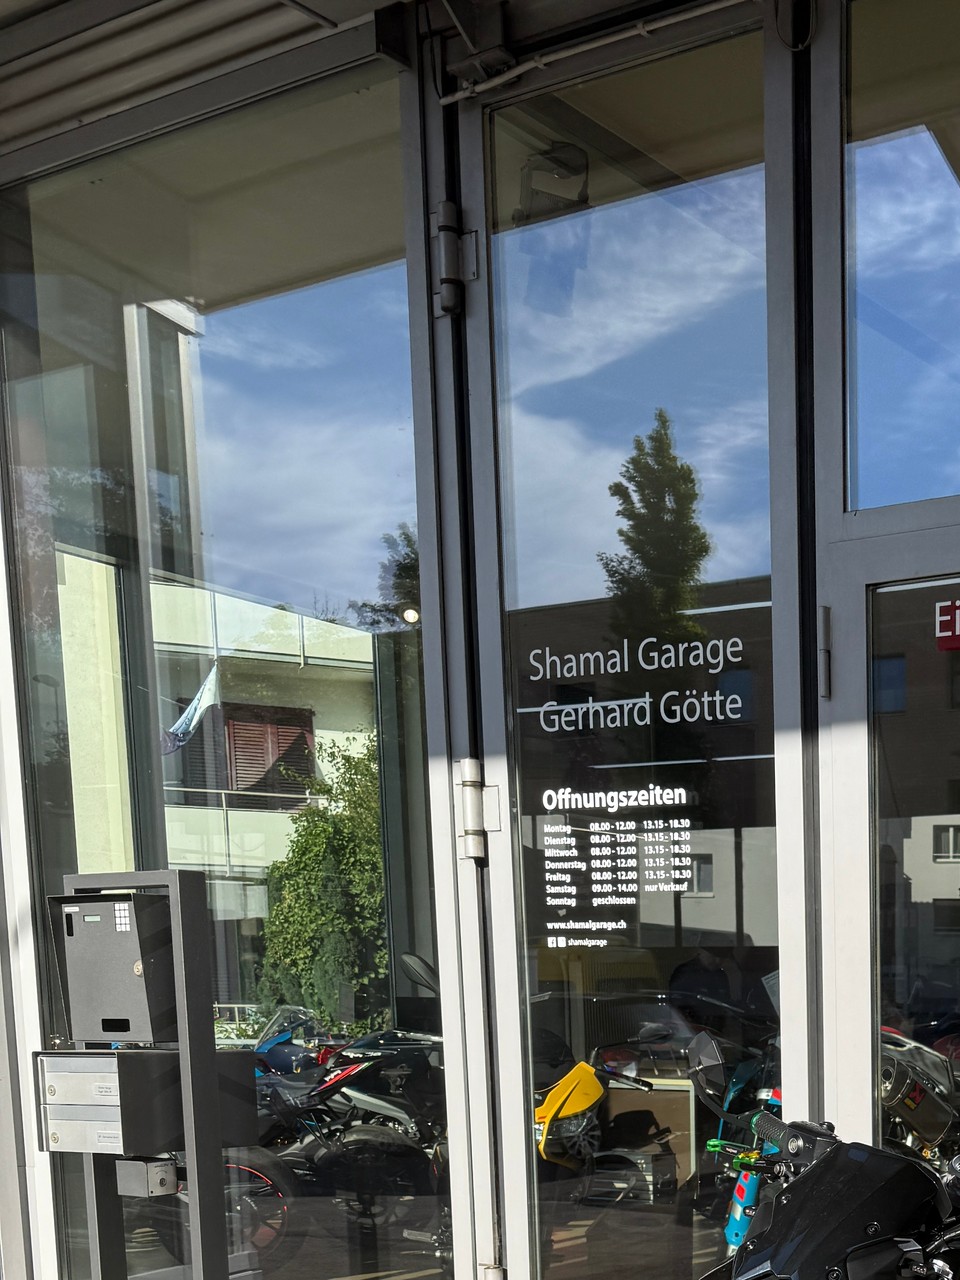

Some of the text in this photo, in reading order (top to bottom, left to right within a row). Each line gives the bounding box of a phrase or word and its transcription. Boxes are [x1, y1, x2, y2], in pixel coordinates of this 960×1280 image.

[529, 637, 743, 681] Shamal Garage
[539, 690, 742, 733] Gerhard Götte
[544, 824, 571, 834] Montag
[643, 820, 664, 829] 13.15
[544, 837, 576, 846] Dienstag
[644, 833, 664, 842] 13.15
[545, 848, 578, 857] Mittwoch
[644, 845, 664, 854] 13.15
[545, 860, 587, 871] Donnerstag
[645, 858, 664, 866] 13.15
[545, 873, 571, 883] Freitag
[645, 870, 665, 879] 13.15
[546, 885, 576, 895] Samstag
[645, 884, 658, 892] nur
[659, 881, 688, 891] Verkauf
[546, 896, 636, 907] Sonntag geschlossen
[547, 920, 627, 930] www.shamalgarage.ch
[568, 938, 607, 947] shamalgarage
